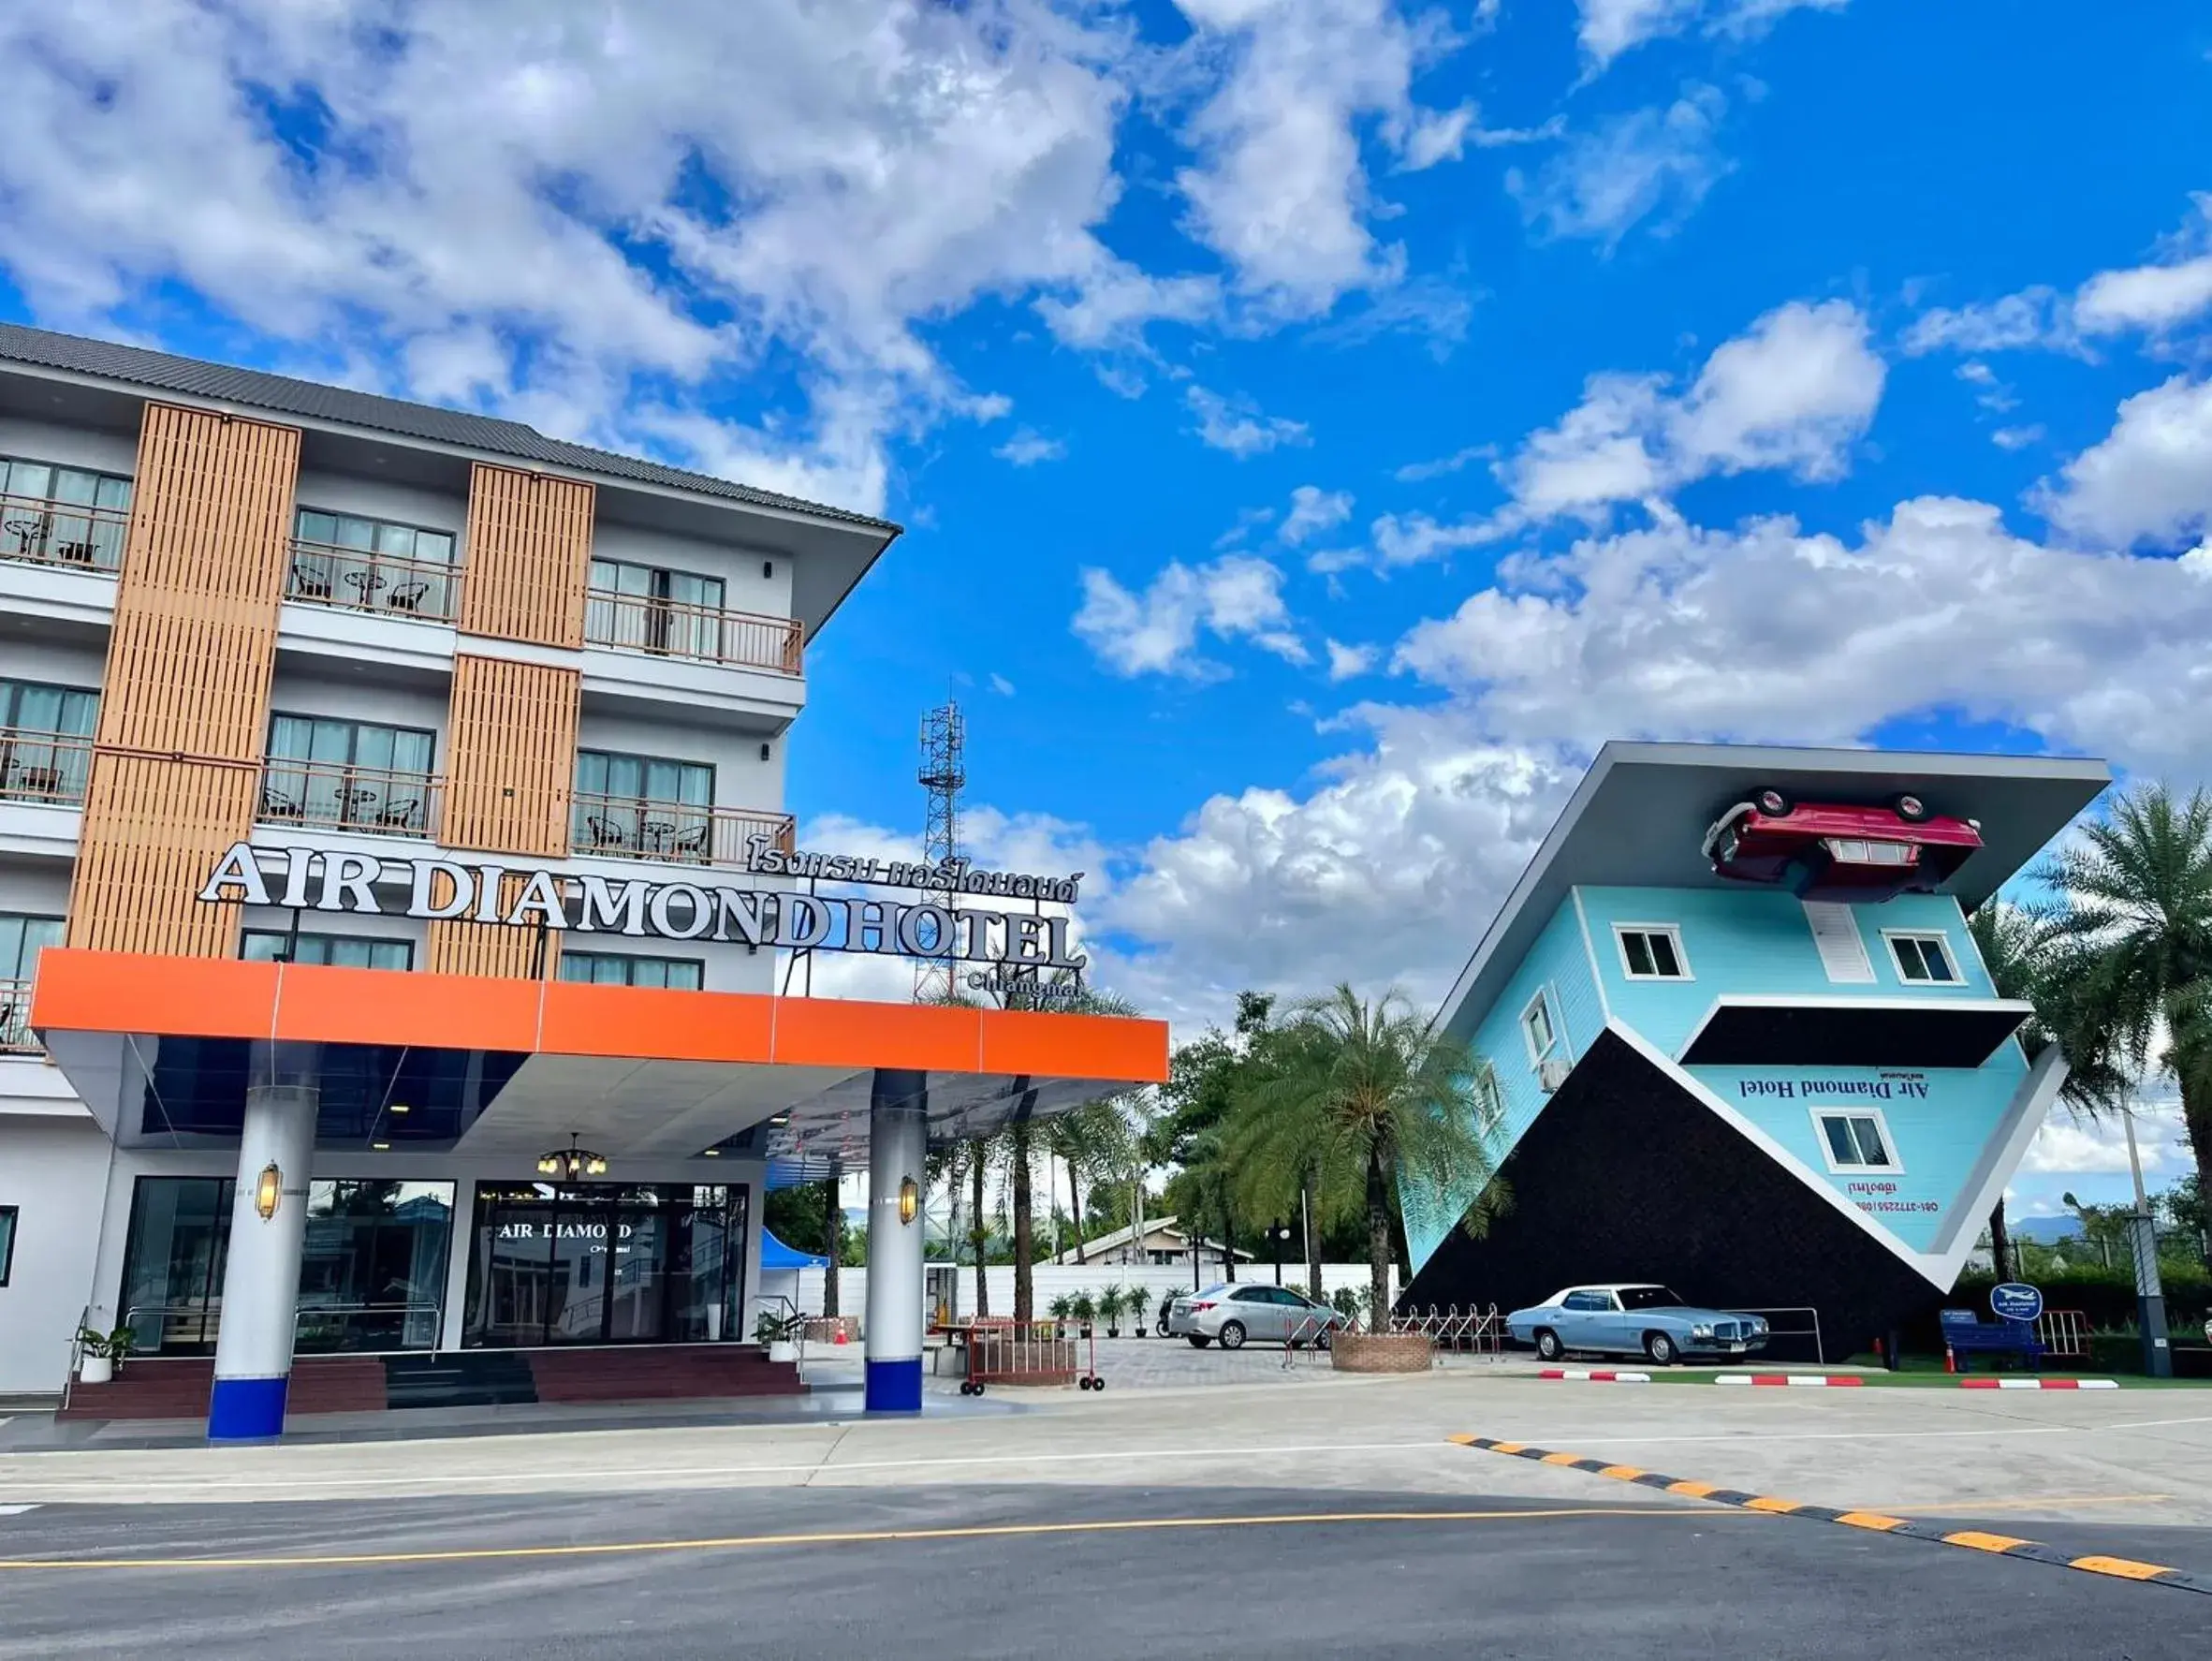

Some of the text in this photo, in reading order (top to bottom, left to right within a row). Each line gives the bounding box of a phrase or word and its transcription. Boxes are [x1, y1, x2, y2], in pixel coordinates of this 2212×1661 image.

[745, 832, 1085, 904] โรงแรม แอร์ไดมอนด์
[196, 840, 1087, 970] AIR DIAMOND HOTEL
[1740, 1080, 1929, 1099] Air Diamond Hotel
[499, 1224, 632, 1239] AIR DIAMOD
